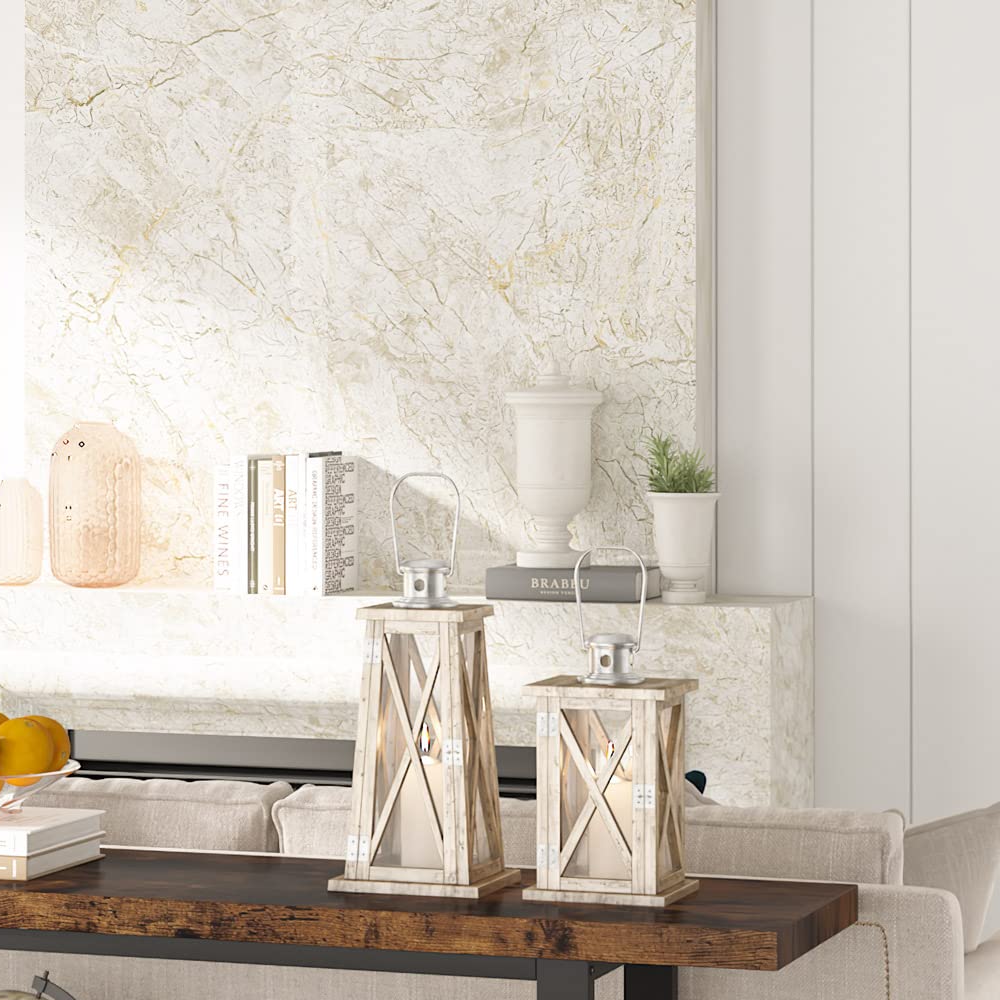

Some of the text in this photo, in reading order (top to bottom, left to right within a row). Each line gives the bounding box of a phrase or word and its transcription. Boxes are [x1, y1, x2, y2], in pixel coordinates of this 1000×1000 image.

[217, 483, 229, 517] FINE
[288, 489, 297, 510] ART
[217, 524, 229, 576] WINES
